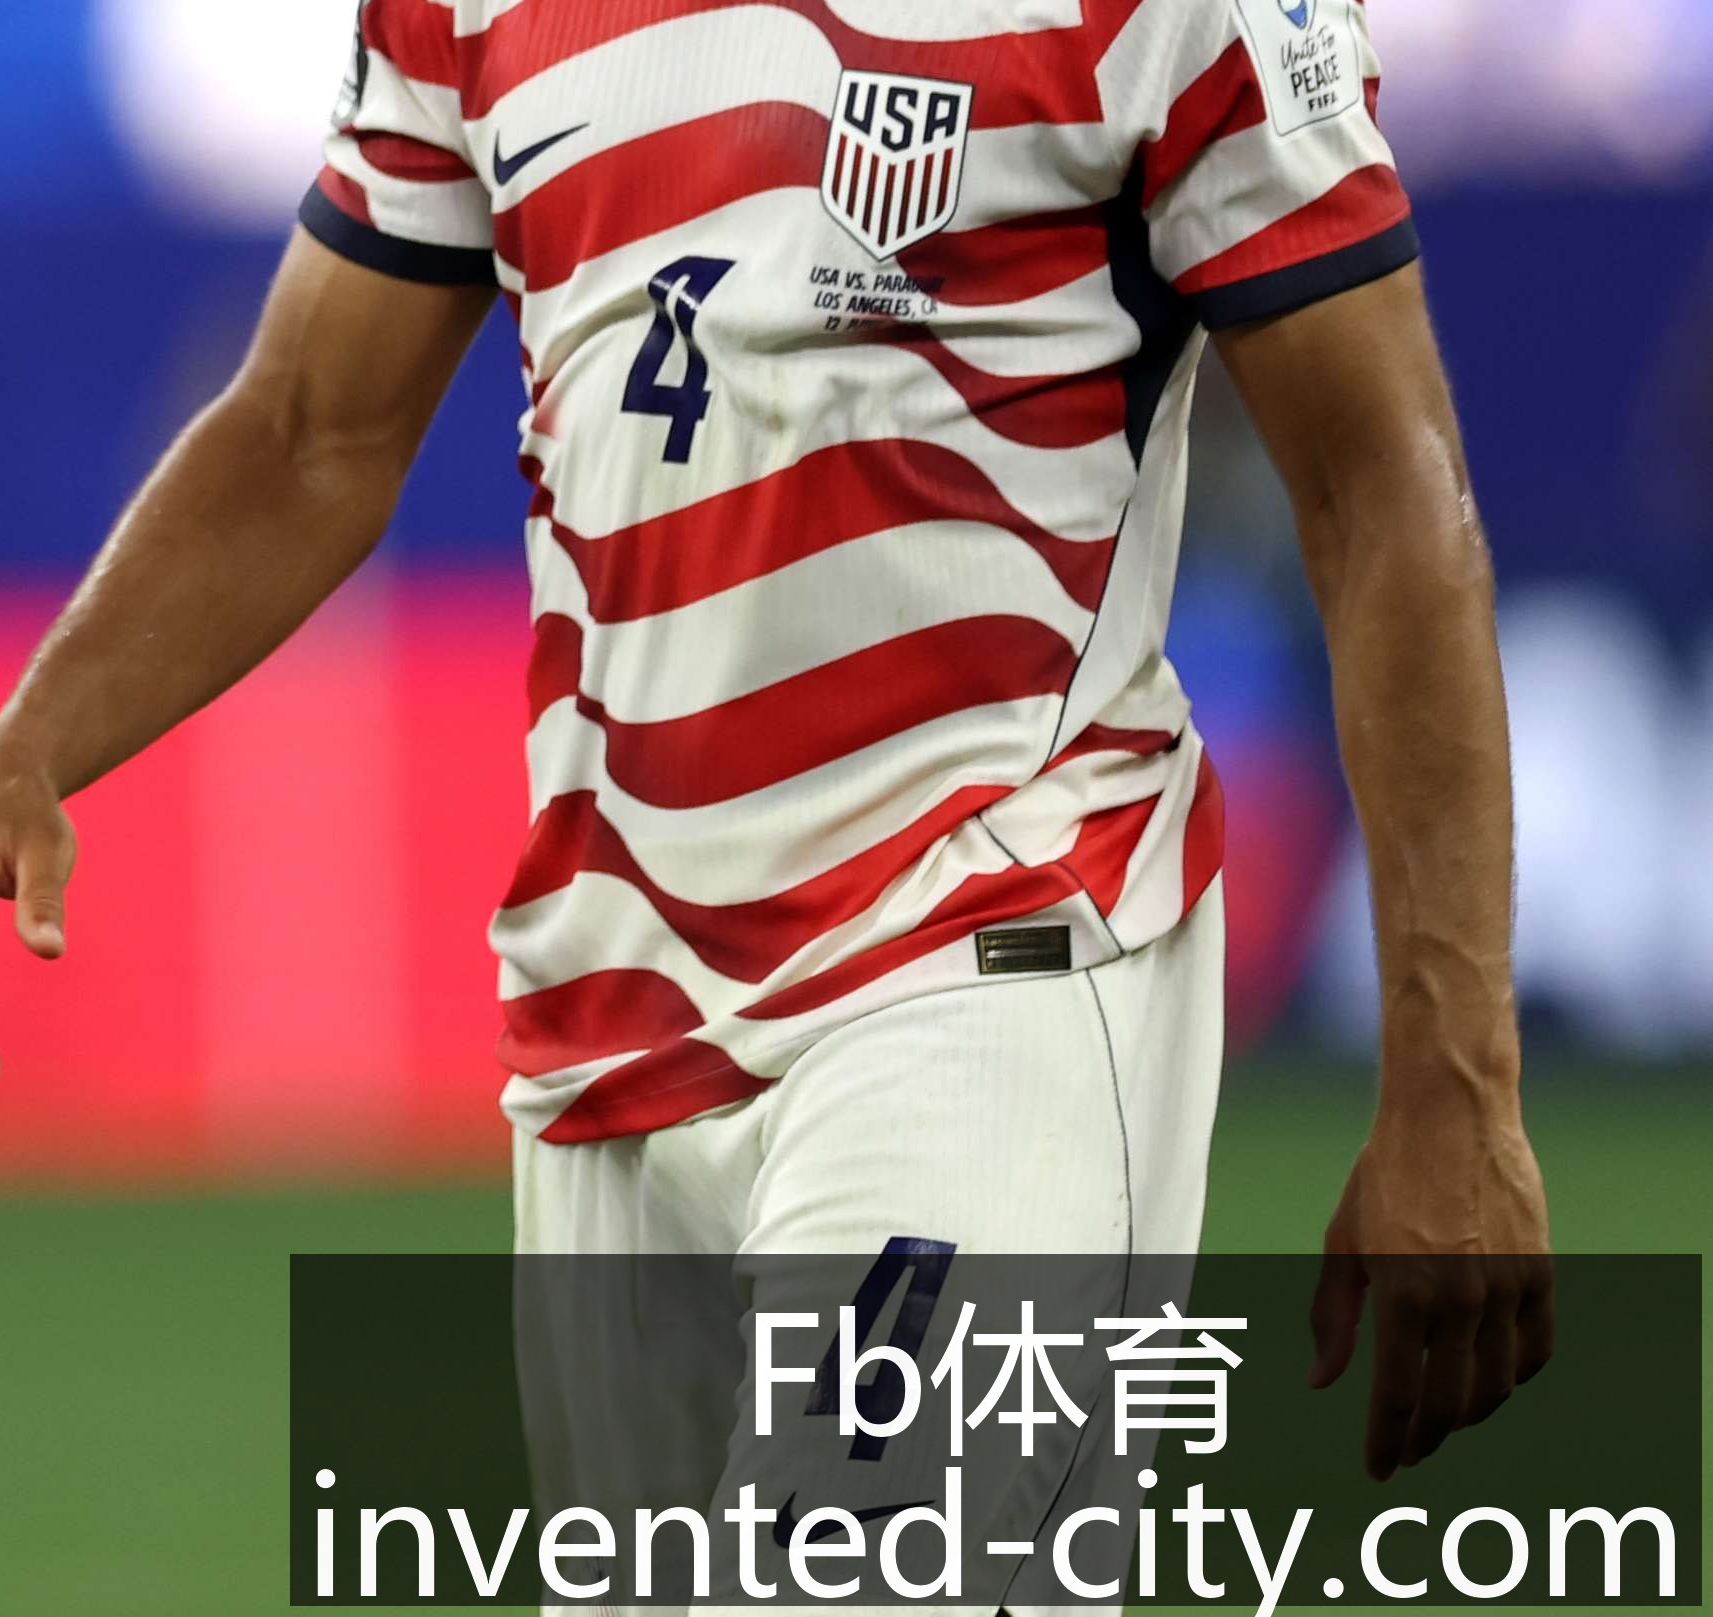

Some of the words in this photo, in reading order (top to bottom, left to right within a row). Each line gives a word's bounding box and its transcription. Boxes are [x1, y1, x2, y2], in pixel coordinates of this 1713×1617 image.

[1290, 53, 1341, 98] PEACE
[844, 81, 961, 152] USA
[810, 266, 840, 285] USA
[874, 274, 945, 294] PARA
[814, 291, 844, 310] LOS
[620, 255, 737, 464] 4
[803, 1236, 958, 1461] 4
